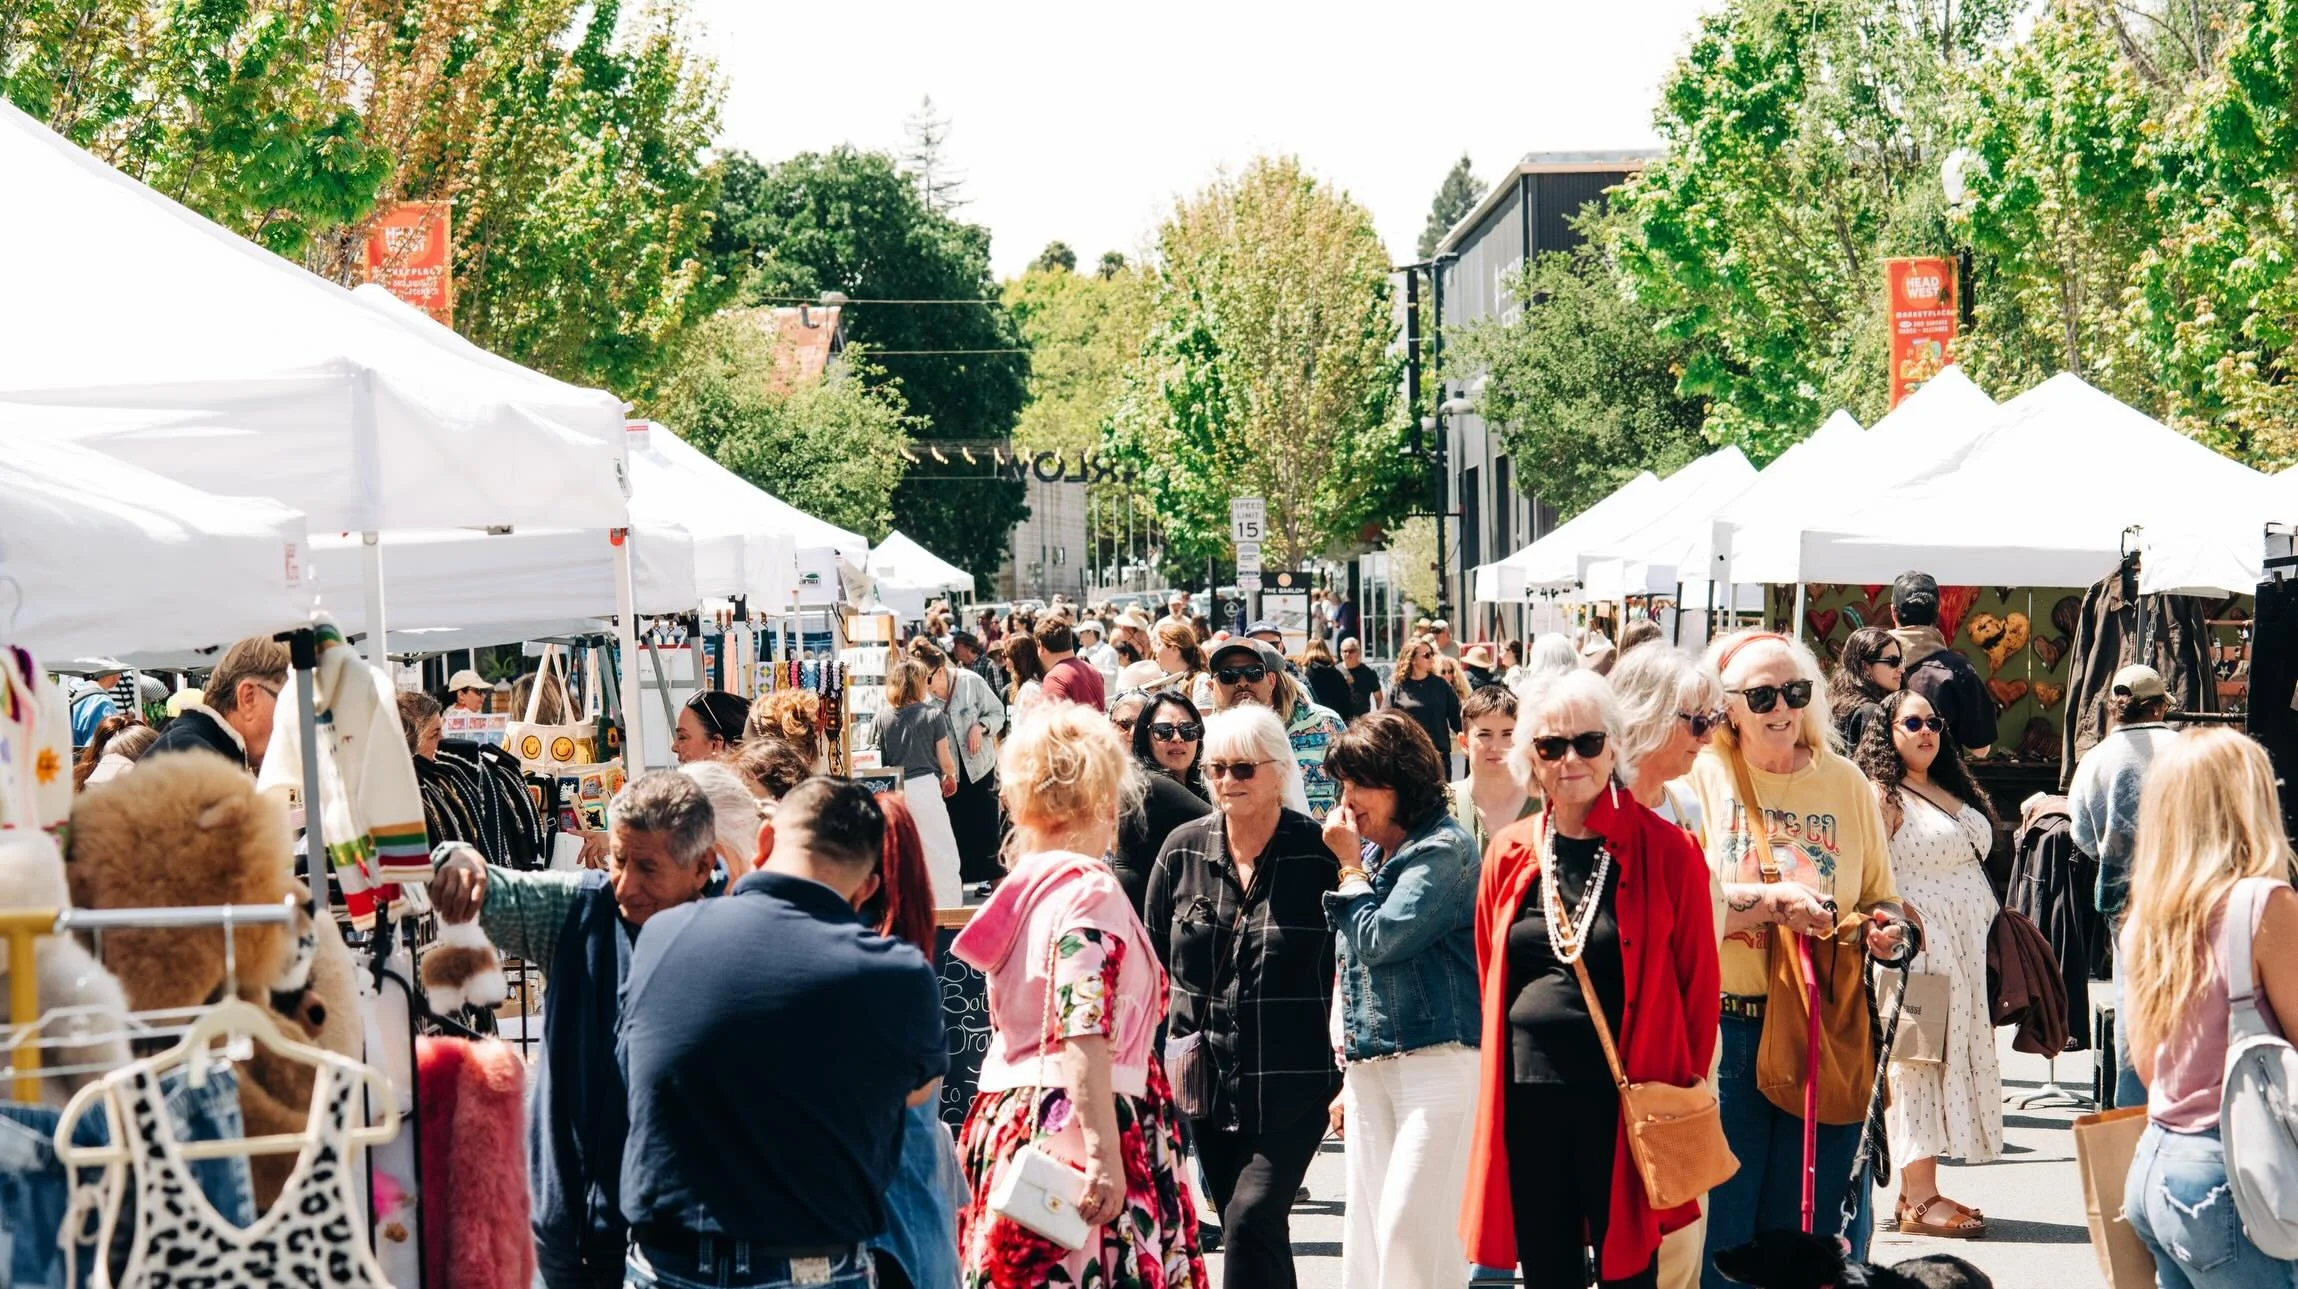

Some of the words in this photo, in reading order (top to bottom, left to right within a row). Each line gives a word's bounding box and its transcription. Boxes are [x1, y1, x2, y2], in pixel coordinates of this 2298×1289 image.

[1906, 276, 1940, 288] HEAD
[1907, 287, 1940, 299] WEST
[1234, 502, 1263, 510] SPEED
[1238, 522, 1259, 538] 15
